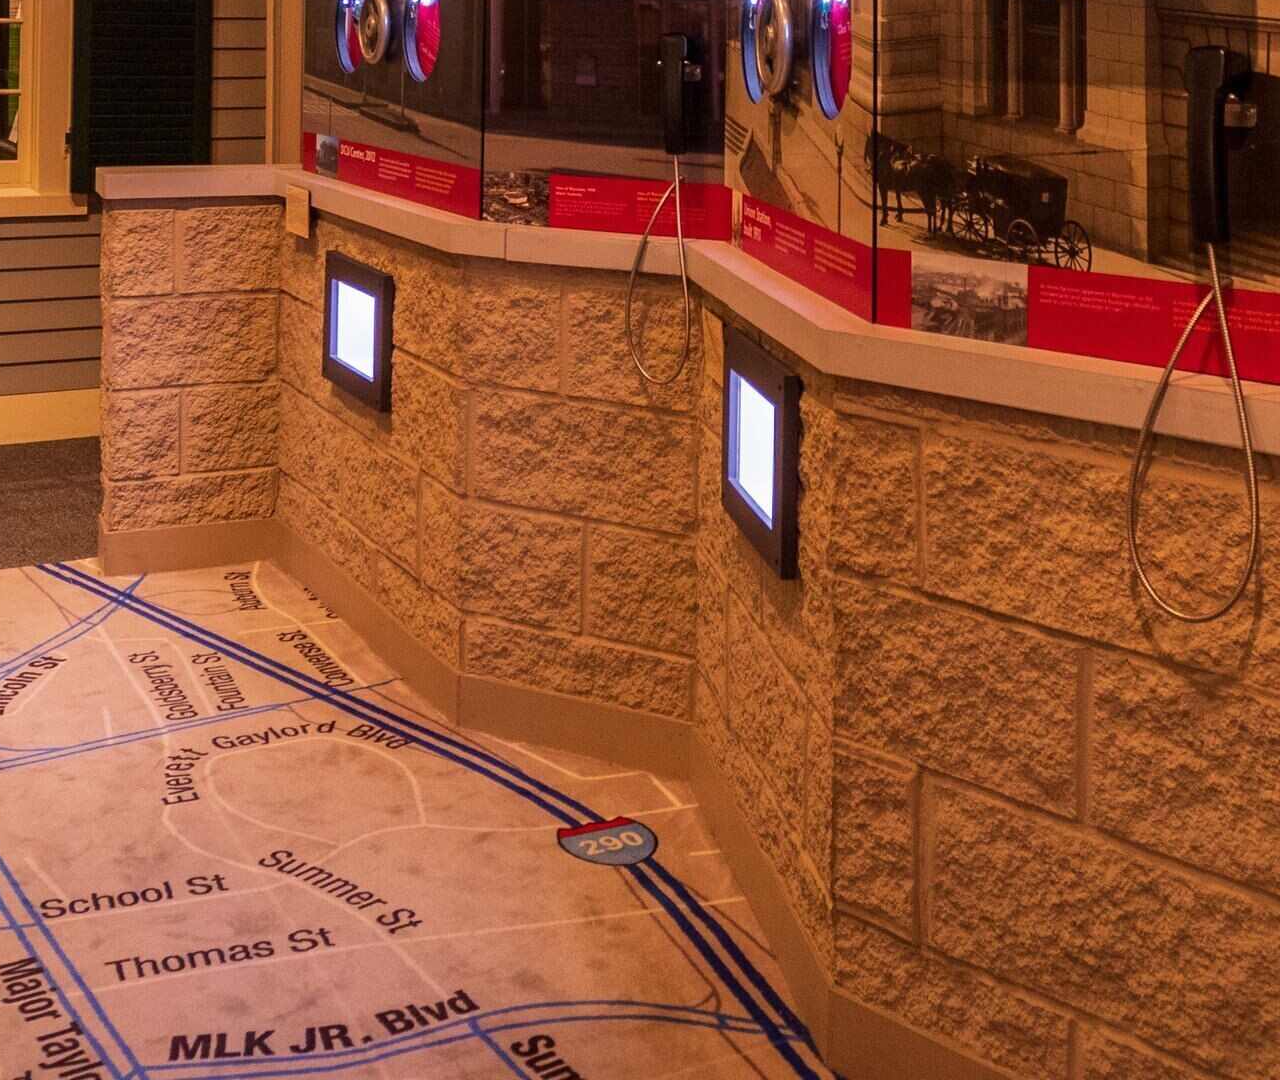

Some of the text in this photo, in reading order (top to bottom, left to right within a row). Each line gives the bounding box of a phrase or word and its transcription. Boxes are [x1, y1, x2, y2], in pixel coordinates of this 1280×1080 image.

[223, 570, 251, 582] St
[29, 655, 68, 670] St
[128, 650, 160, 665] St
[191, 650, 250, 713] Fountain St
[276, 629, 355, 688] Converse St
[211, 720, 414, 750] Gaylord Blvd
[161, 747, 209, 806] Everett
[578, 829, 646, 857] 290
[39, 873, 229, 920] School St
[257, 848, 423, 936] Summer St
[104, 926, 336, 982] Thomas St
[168, 988, 480, 1062] MLK JR. Blvd
